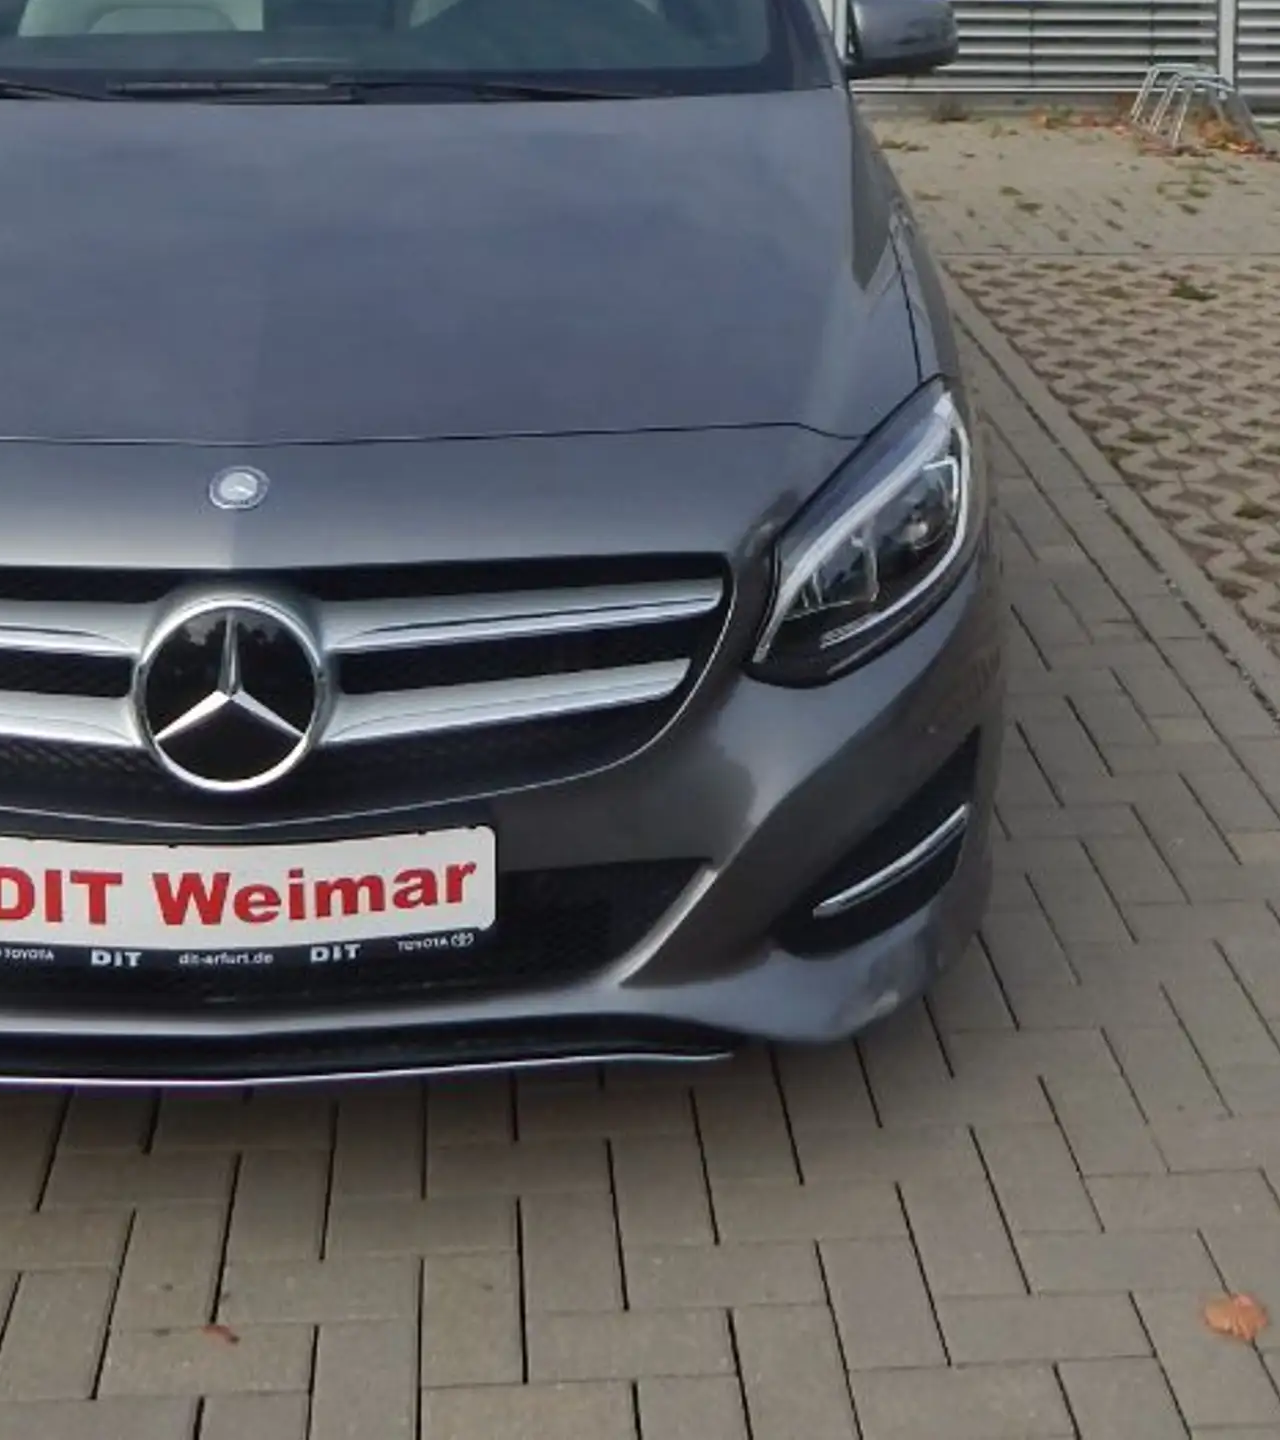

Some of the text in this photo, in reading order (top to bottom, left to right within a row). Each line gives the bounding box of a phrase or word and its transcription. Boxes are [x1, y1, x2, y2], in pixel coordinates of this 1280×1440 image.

[151, 860, 478, 926] Weimar
[4, 947, 56, 961] TOYOTA
[90, 948, 143, 968] DIT
[309, 943, 362, 963] DIT
[397, 936, 450, 952] TOYOTA
